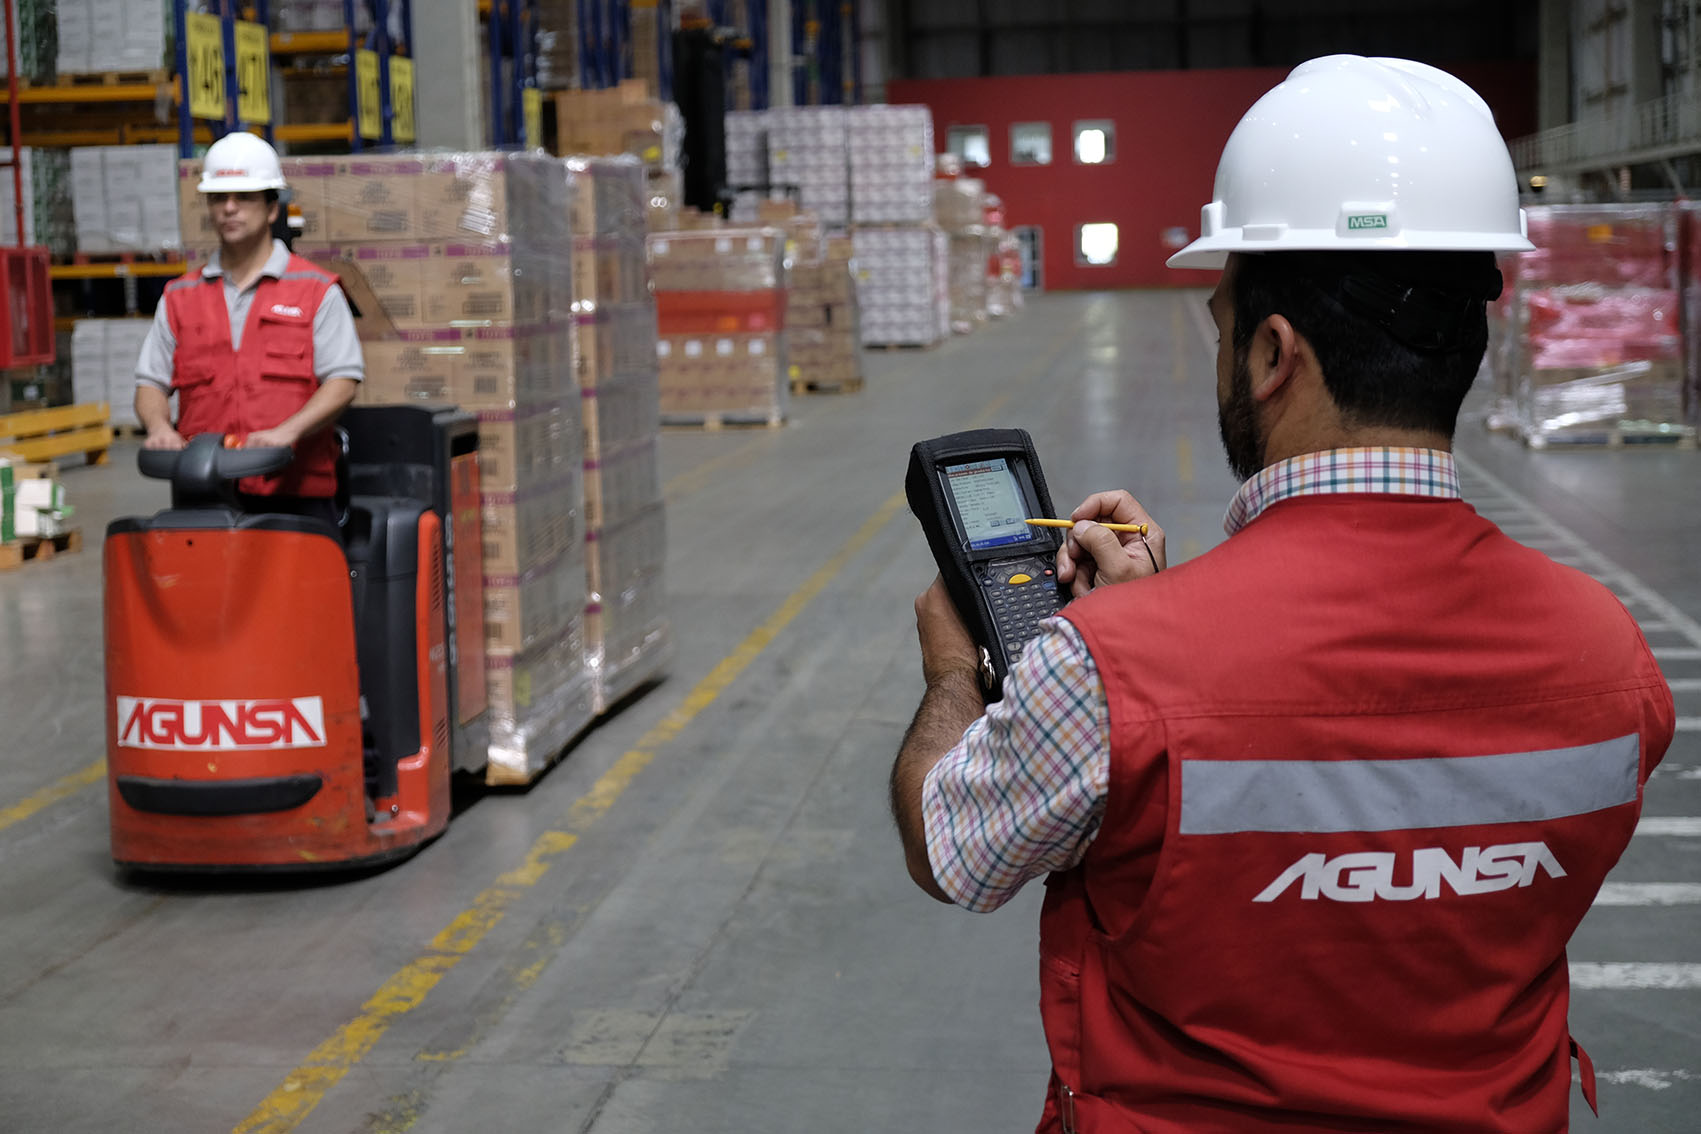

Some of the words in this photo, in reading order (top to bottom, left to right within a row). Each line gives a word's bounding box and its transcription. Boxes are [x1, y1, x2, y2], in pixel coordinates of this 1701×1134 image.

[1350, 216, 1385, 228] MSA
[122, 699, 321, 746] AGUNSA
[1252, 841, 1567, 902] AGUNSA
